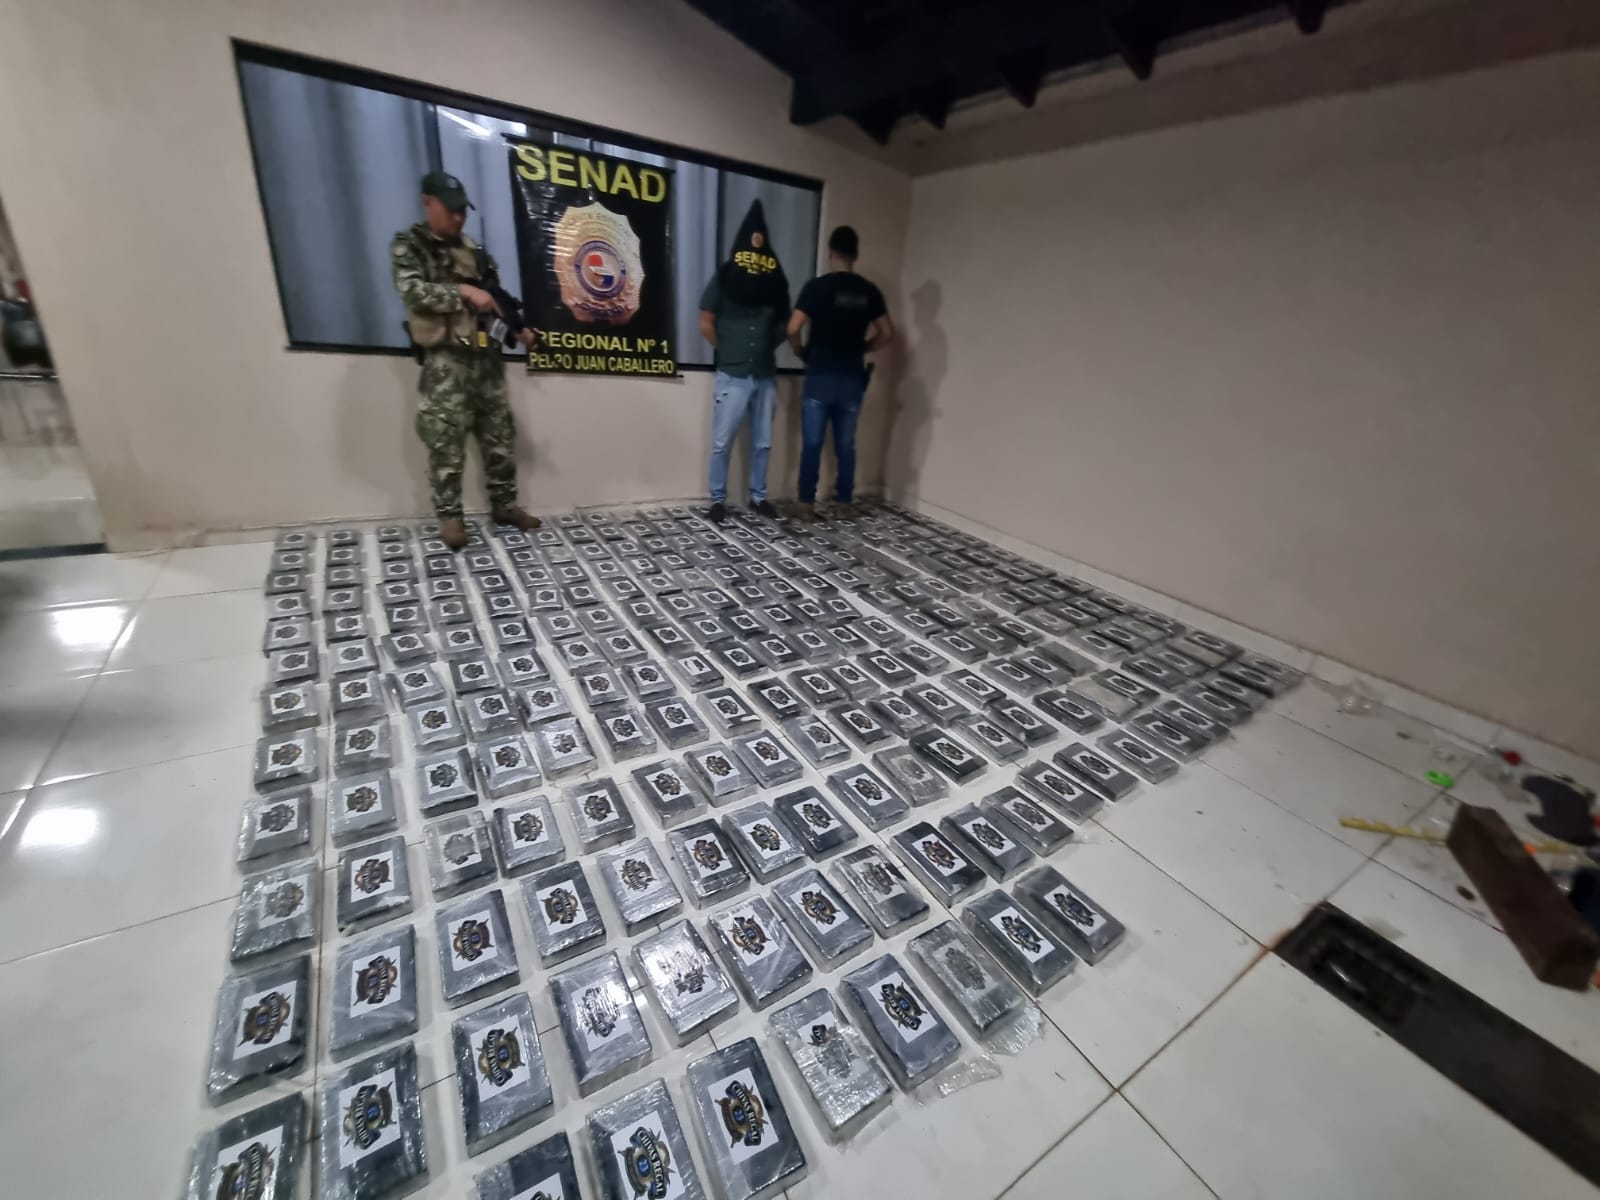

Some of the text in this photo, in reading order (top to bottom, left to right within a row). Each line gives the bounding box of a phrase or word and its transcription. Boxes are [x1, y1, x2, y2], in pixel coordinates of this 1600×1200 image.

[516, 143, 666, 203] SENAD
[735, 251, 777, 269] SENAD
[660, 340, 668, 353] 1
[575, 354, 605, 371] JUAN
[608, 356, 674, 374] CABALLERO
[490, 1060, 506, 1085] CHIVAS
[731, 1082, 760, 1142] CHIVAS REGAL
[637, 1130, 664, 1196] CHIVAS REGAL
